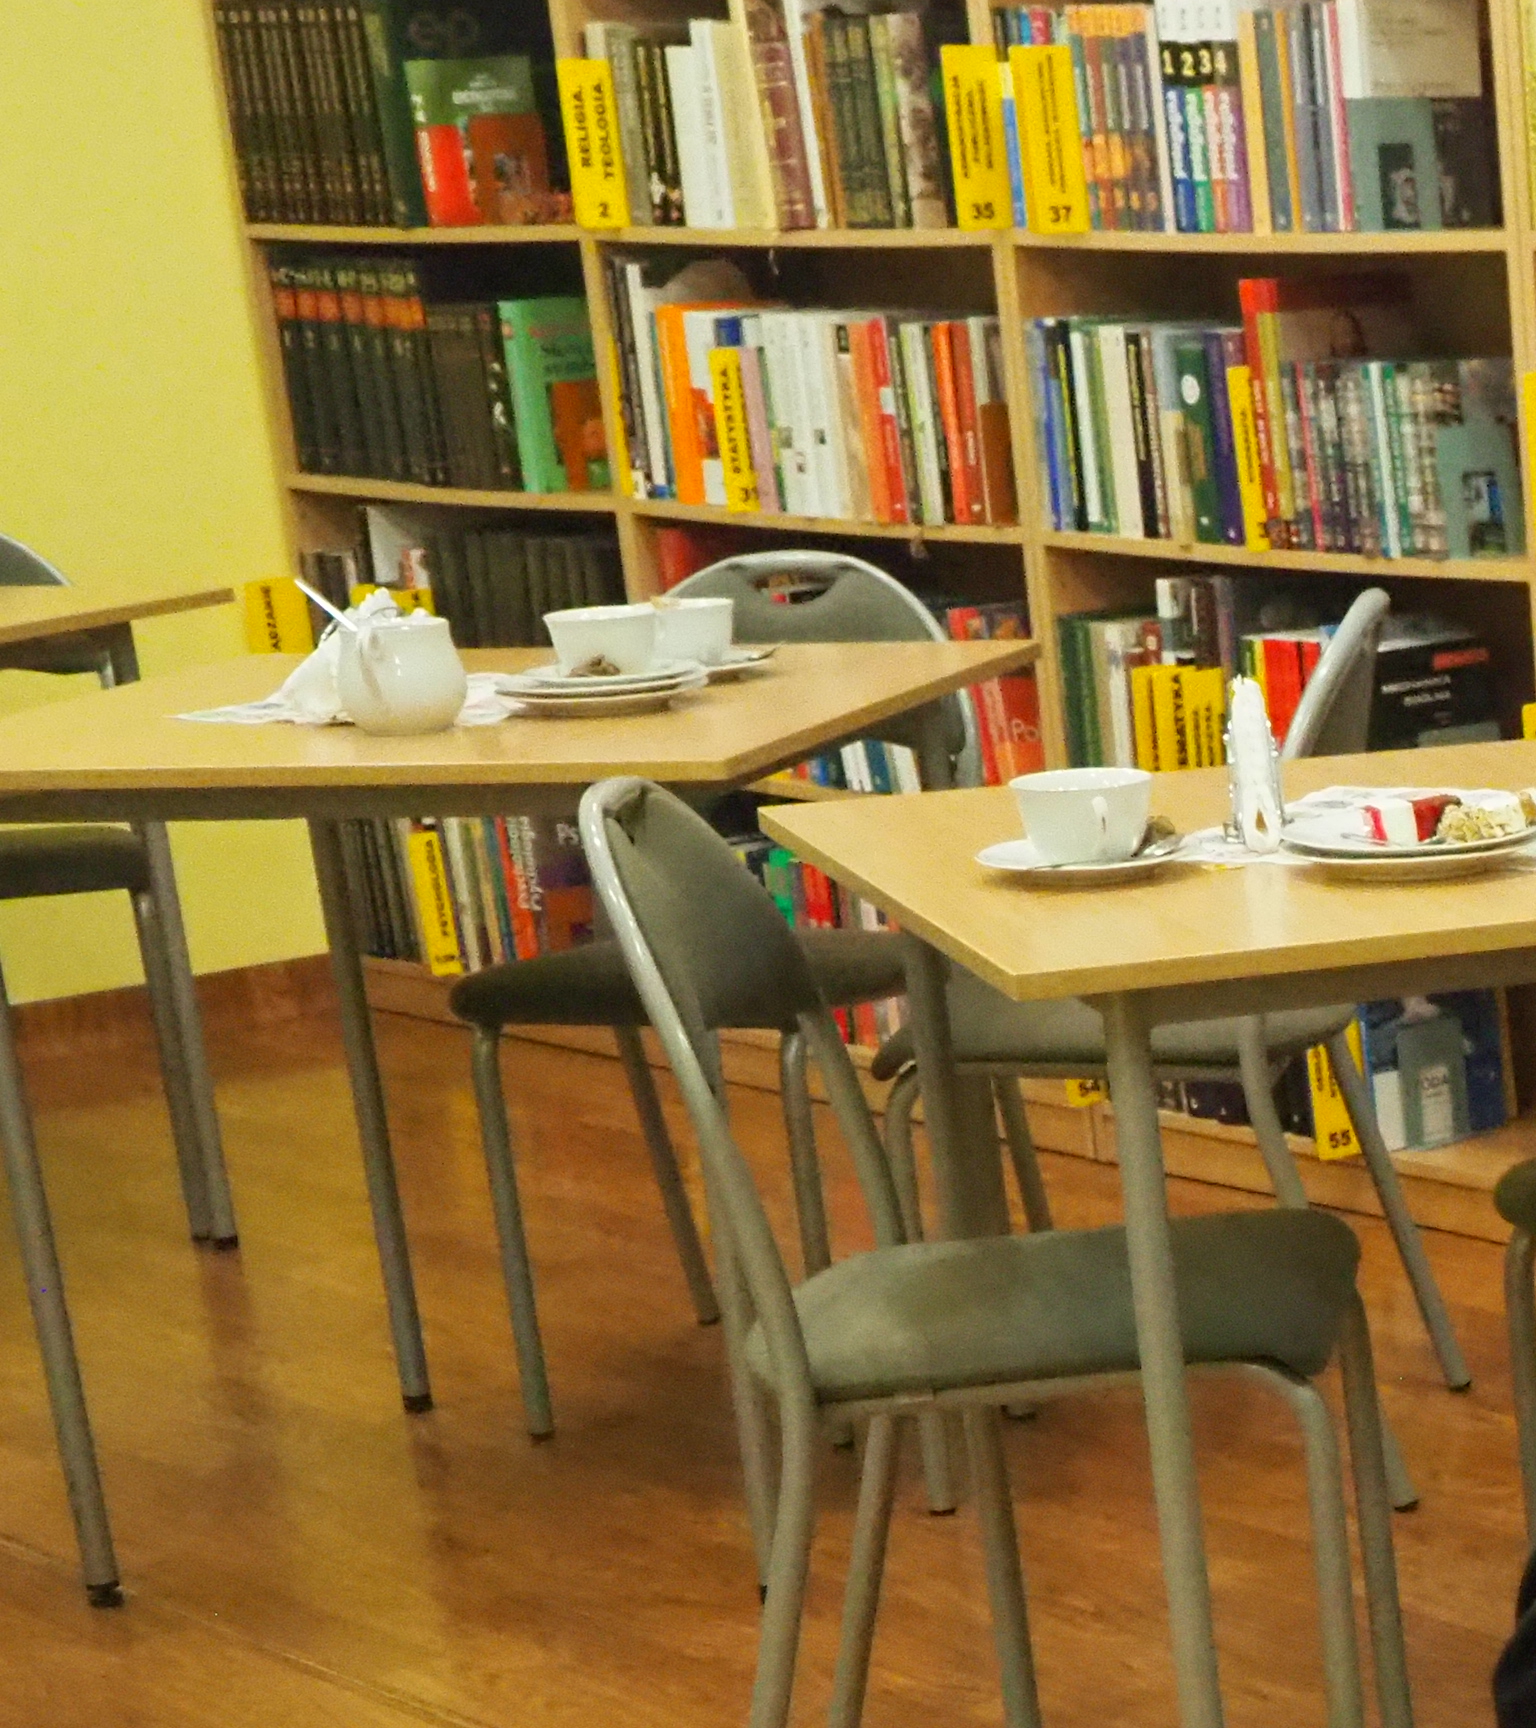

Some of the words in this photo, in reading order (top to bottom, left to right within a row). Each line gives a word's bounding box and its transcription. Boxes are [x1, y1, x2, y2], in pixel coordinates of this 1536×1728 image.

[1163, 50, 1175, 75] 1
[1180, 53, 1195, 77] 2
[1199, 49, 1213, 74] 3
[592, 83, 618, 180] TEOLOGIA
[599, 202, 614, 219] 2
[972, 203, 995, 222] 35
[1049, 205, 1073, 224] 37
[719, 367, 743, 476] STATYSTYKA
[427, 838, 453, 938] PSYCHOLOGIA
[1328, 1127, 1354, 1151] 55
